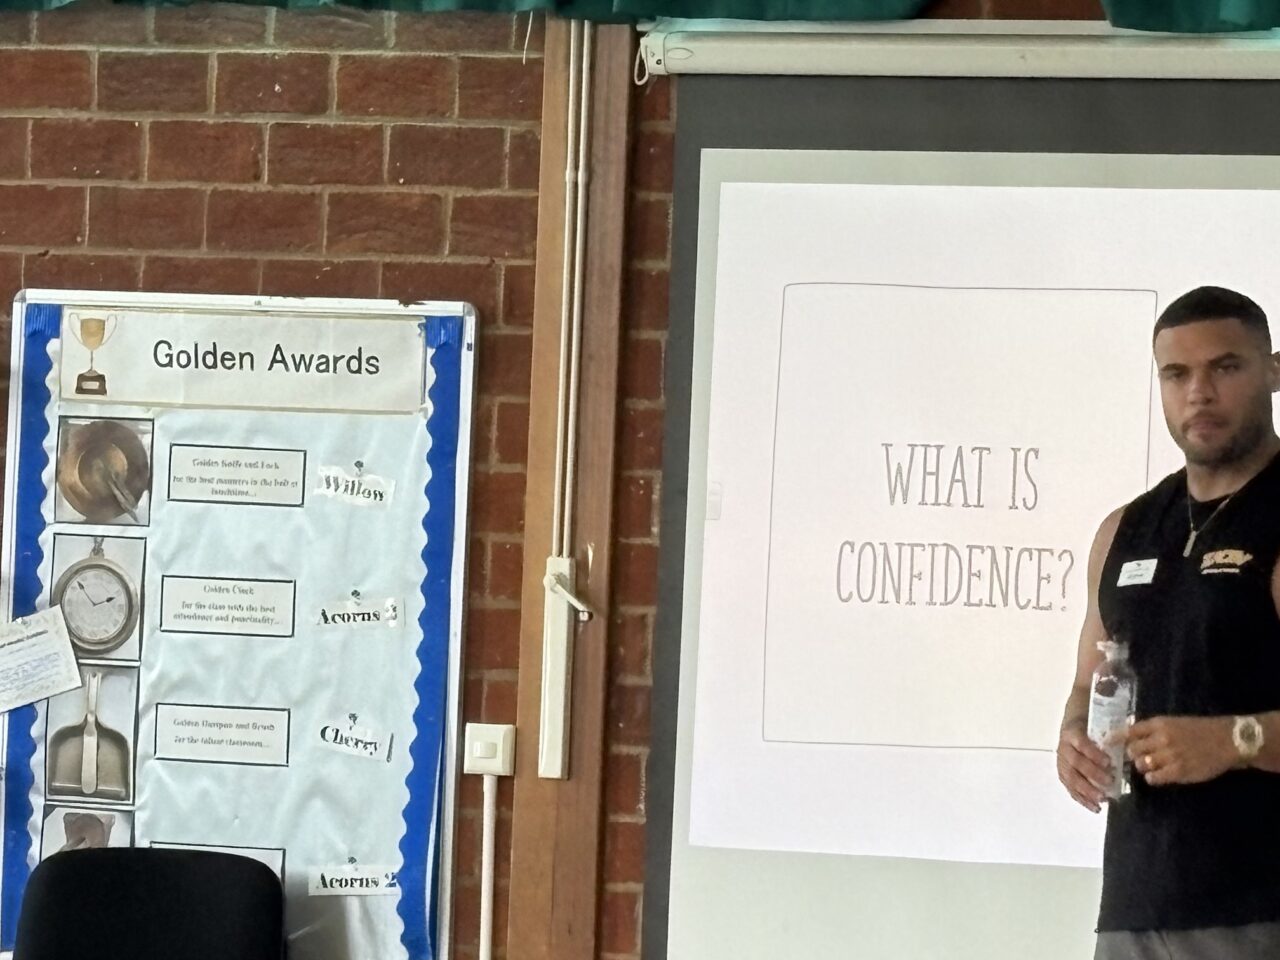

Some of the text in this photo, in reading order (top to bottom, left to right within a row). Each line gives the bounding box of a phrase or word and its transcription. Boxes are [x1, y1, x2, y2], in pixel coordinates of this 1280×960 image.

[153, 339, 380, 375] Golden Awards
[324, 474, 384, 502] Willow
[881, 443, 1040, 511] WHAT IS
[836, 540, 1075, 611] CONFIDENCE?
[317, 608, 381, 625] Acorns
[320, 725, 379, 756] Cherry
[316, 872, 380, 889] Acorns
